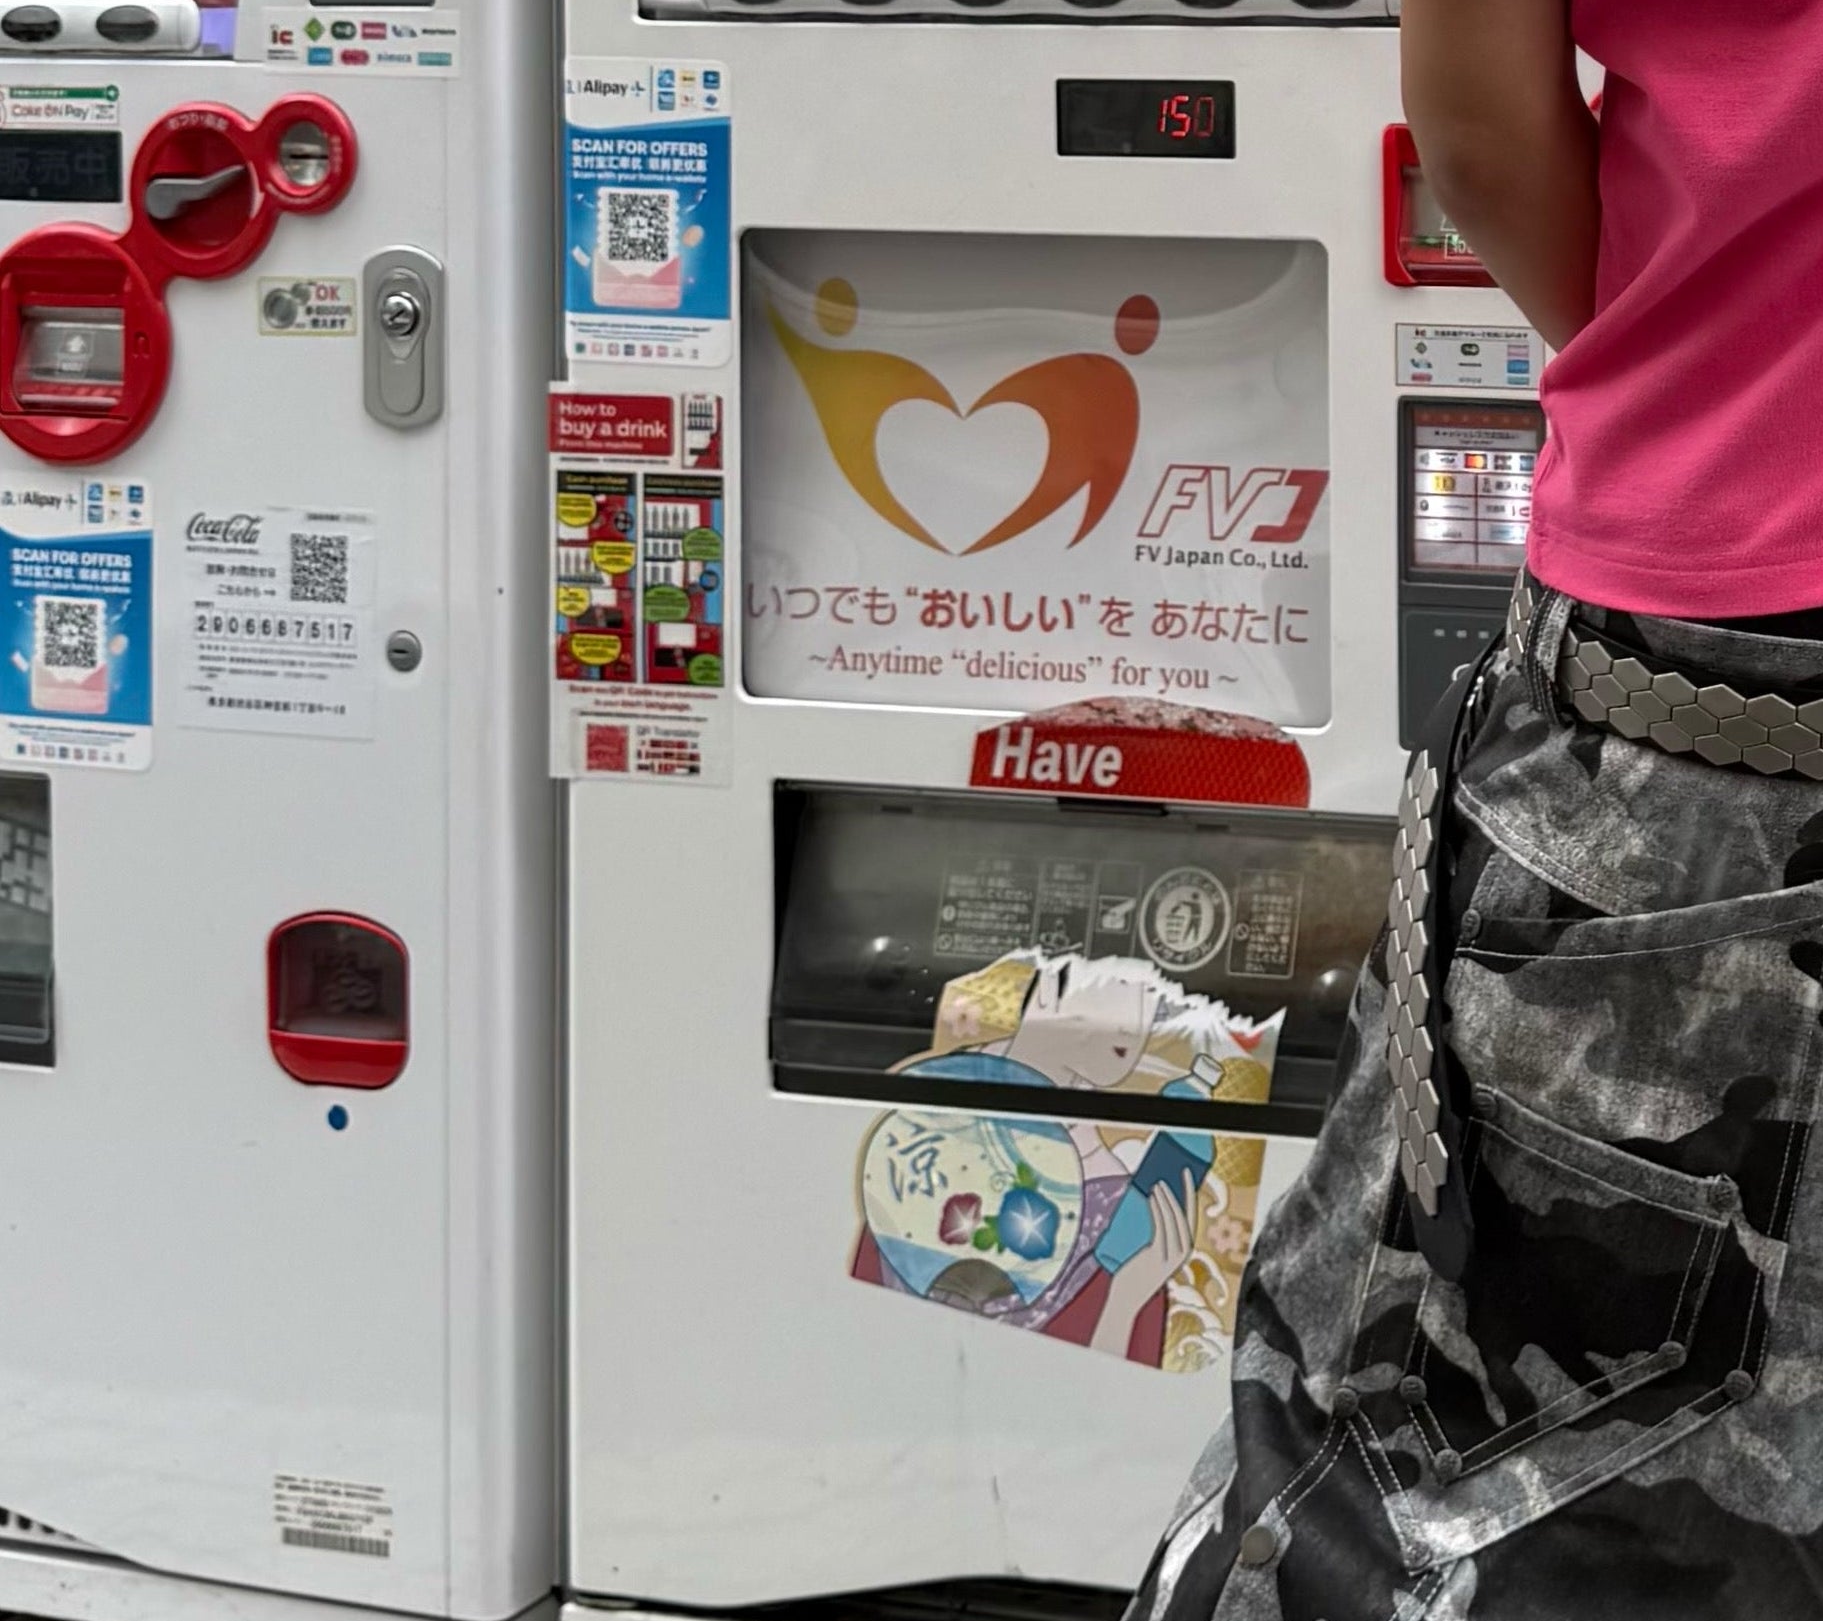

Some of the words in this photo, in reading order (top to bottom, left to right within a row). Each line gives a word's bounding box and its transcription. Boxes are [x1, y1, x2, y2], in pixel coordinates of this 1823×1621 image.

[560, 401, 597, 416] How
[600, 402, 617, 417] to
[560, 419, 597, 439] buy
[600, 422, 612, 437] a
[617, 419, 668, 438] drink
[1136, 464, 1330, 544] FVJ
[1135, 545, 1160, 563] FV
[1165, 545, 1223, 568] Japan
[1112, 655, 1151, 686] for
[1160, 665, 1210, 694] you
[991, 726, 1123, 786] Have
